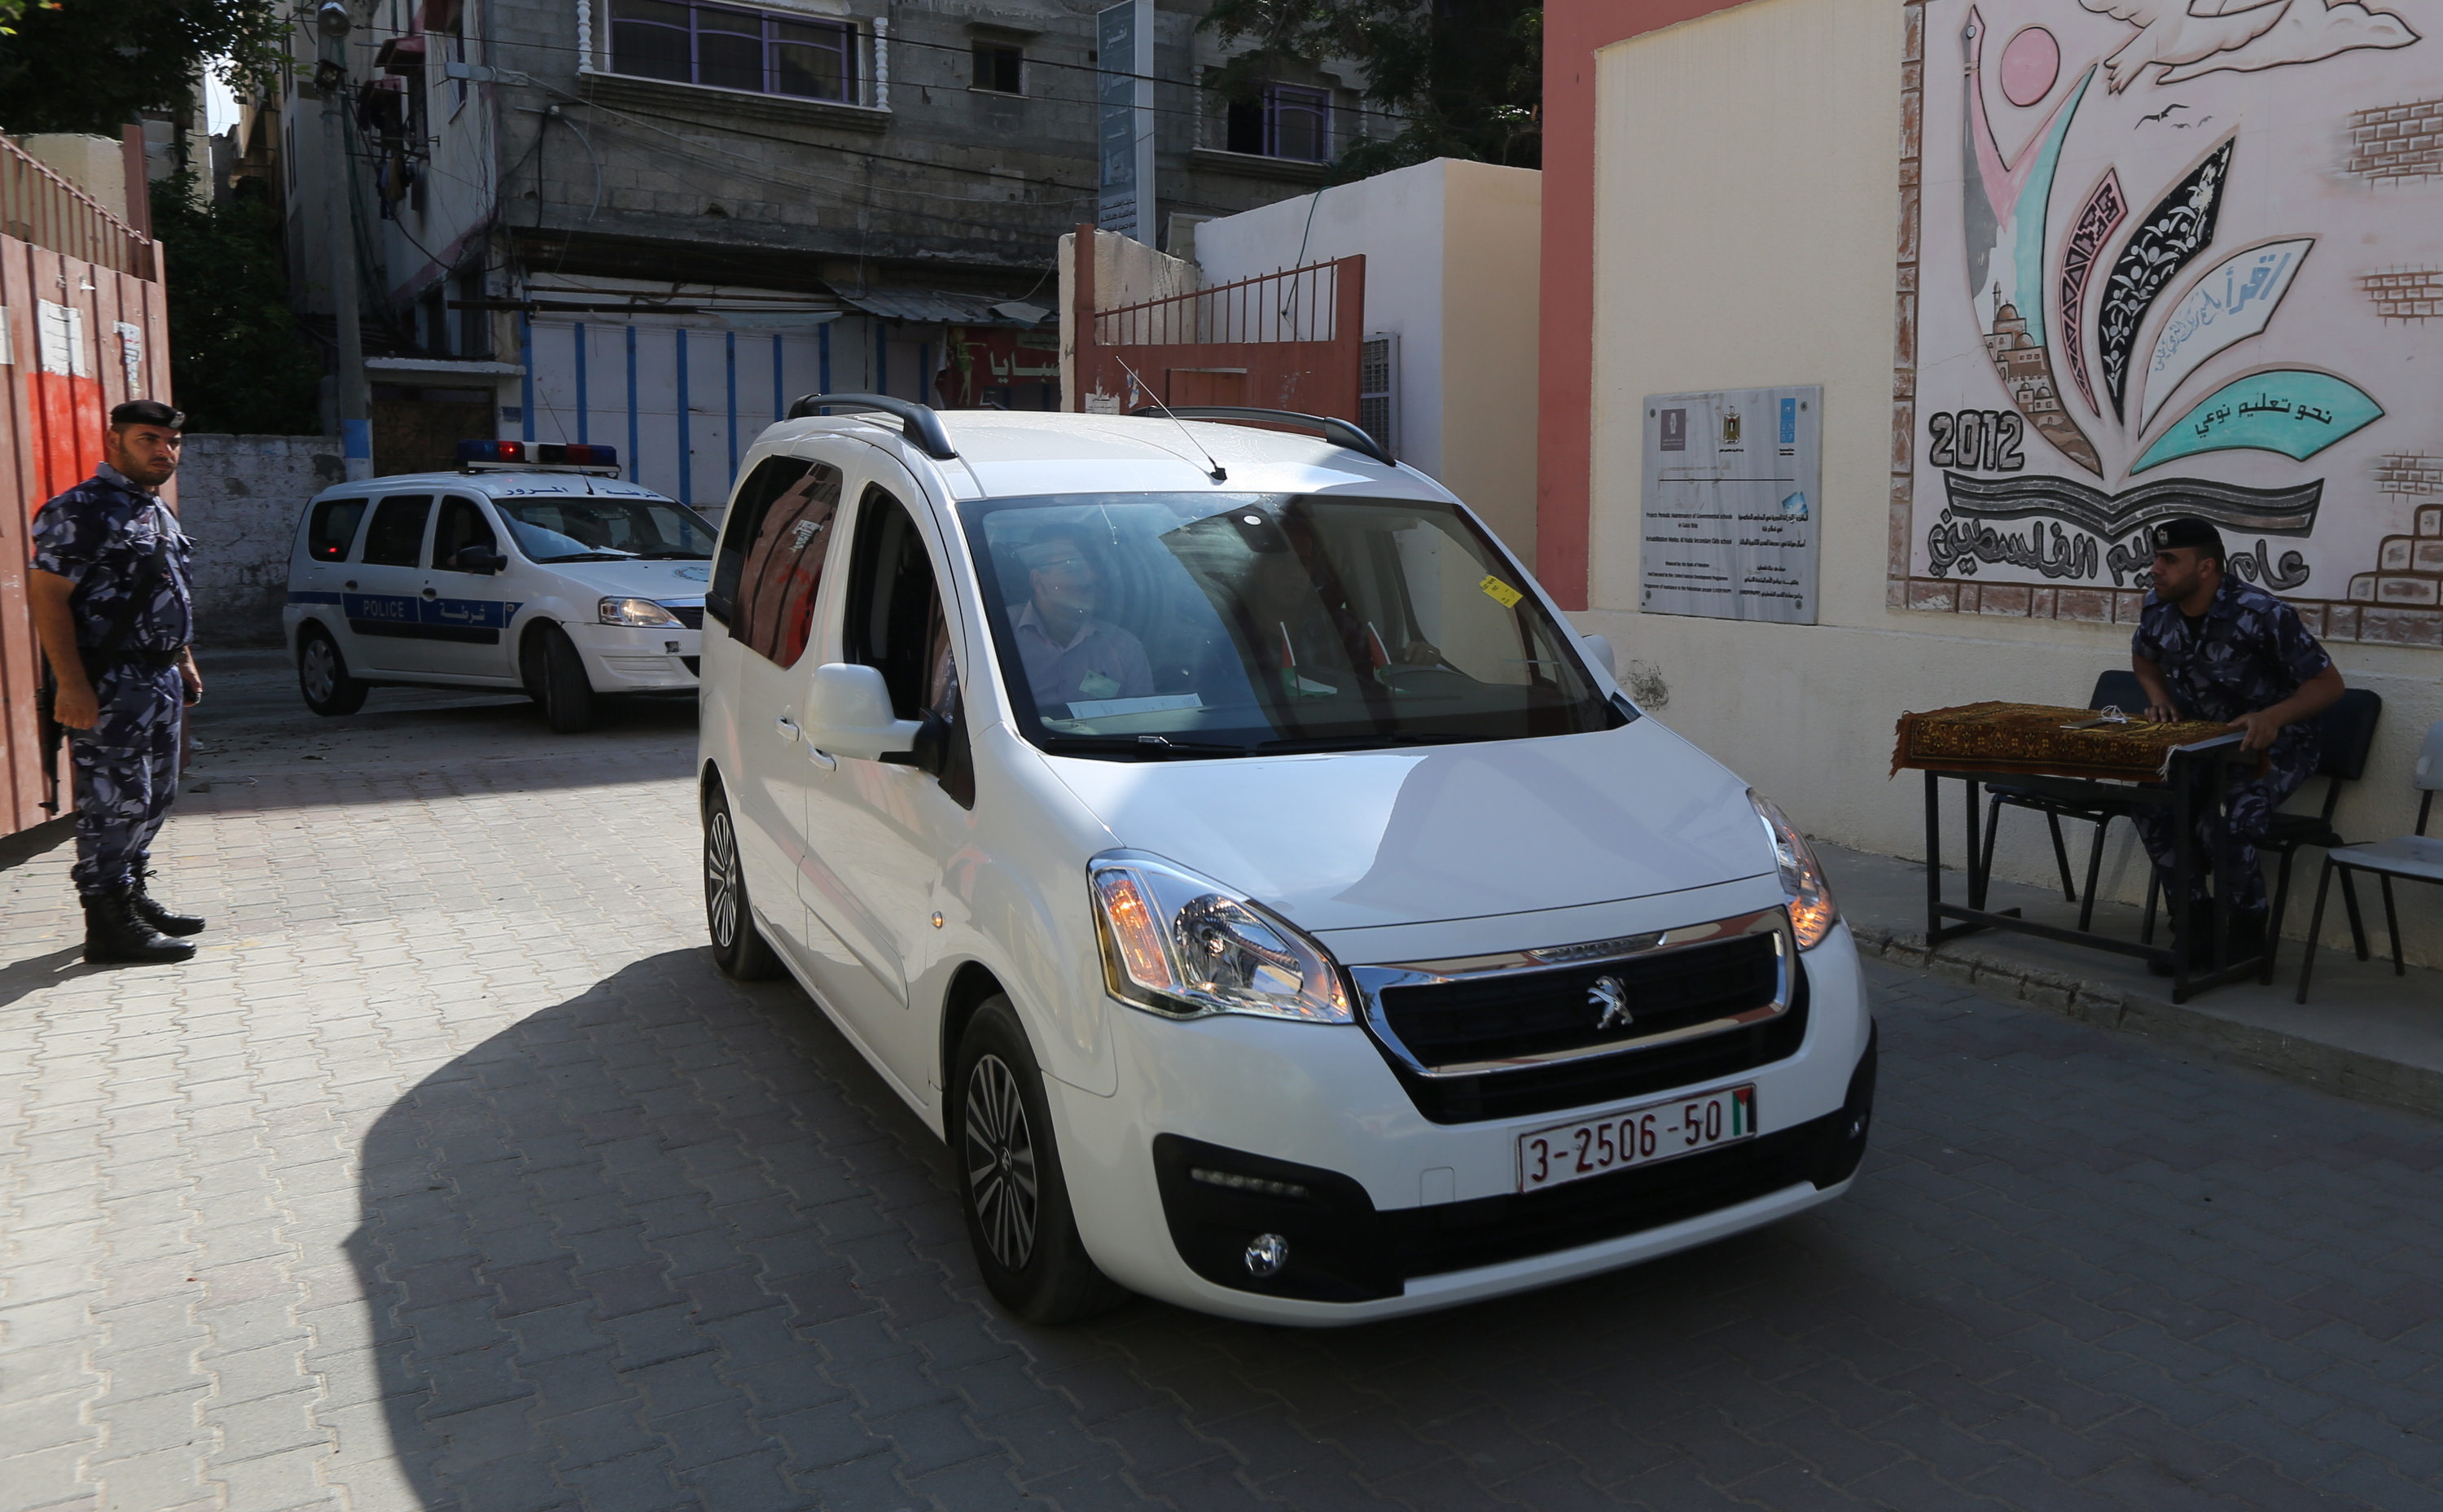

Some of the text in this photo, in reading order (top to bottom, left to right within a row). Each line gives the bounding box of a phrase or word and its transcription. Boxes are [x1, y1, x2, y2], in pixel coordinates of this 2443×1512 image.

[2226, 252, 2292, 315] اقرأ
[1928, 409, 2024, 471] 2012
[2195, 392, 2332, 439] نحو تعليم نوعي
[506, 486, 660, 497] شرطة المرور
[1928, 508, 2099, 578] الفلسطيني
[2226, 538, 2309, 591] عام
[364, 600, 404, 617] POLICE
[439, 602, 485, 624] شرطة
[1530, 1100, 1722, 1181] 3-2506-50
